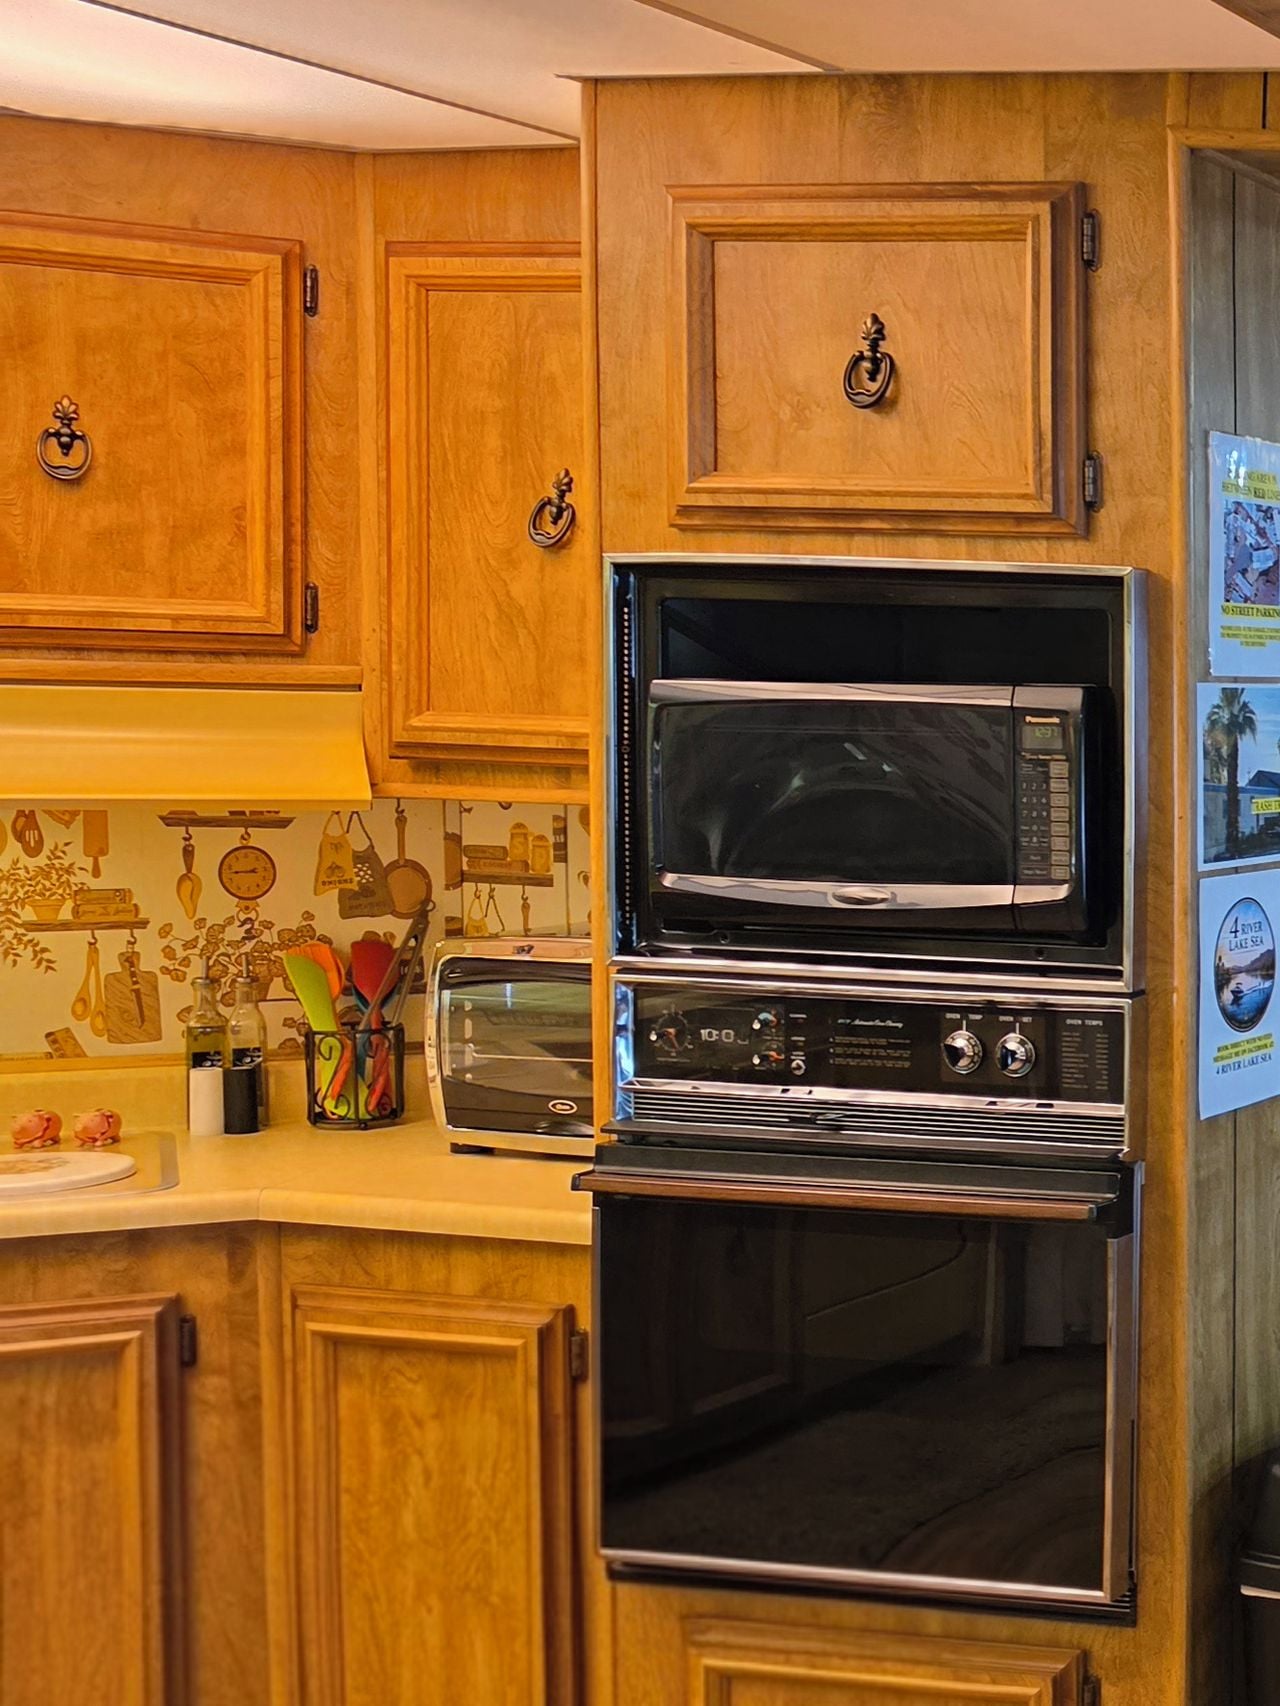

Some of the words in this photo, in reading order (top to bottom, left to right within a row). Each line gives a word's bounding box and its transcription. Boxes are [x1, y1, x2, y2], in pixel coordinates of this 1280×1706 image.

[1221, 605, 1231, 615] NO
[1231, 606, 1254, 617] STREET
[1229, 916, 1240, 939] 4
[1241, 921, 1263, 935] RIVER
[1229, 938, 1249, 951] LAKE
[1250, 935, 1265, 948] SEA
[1221, 1060, 1242, 1075] RIVER
[1243, 1055, 1259, 1068] LAKE
[1260, 1052, 1272, 1064] SEA
